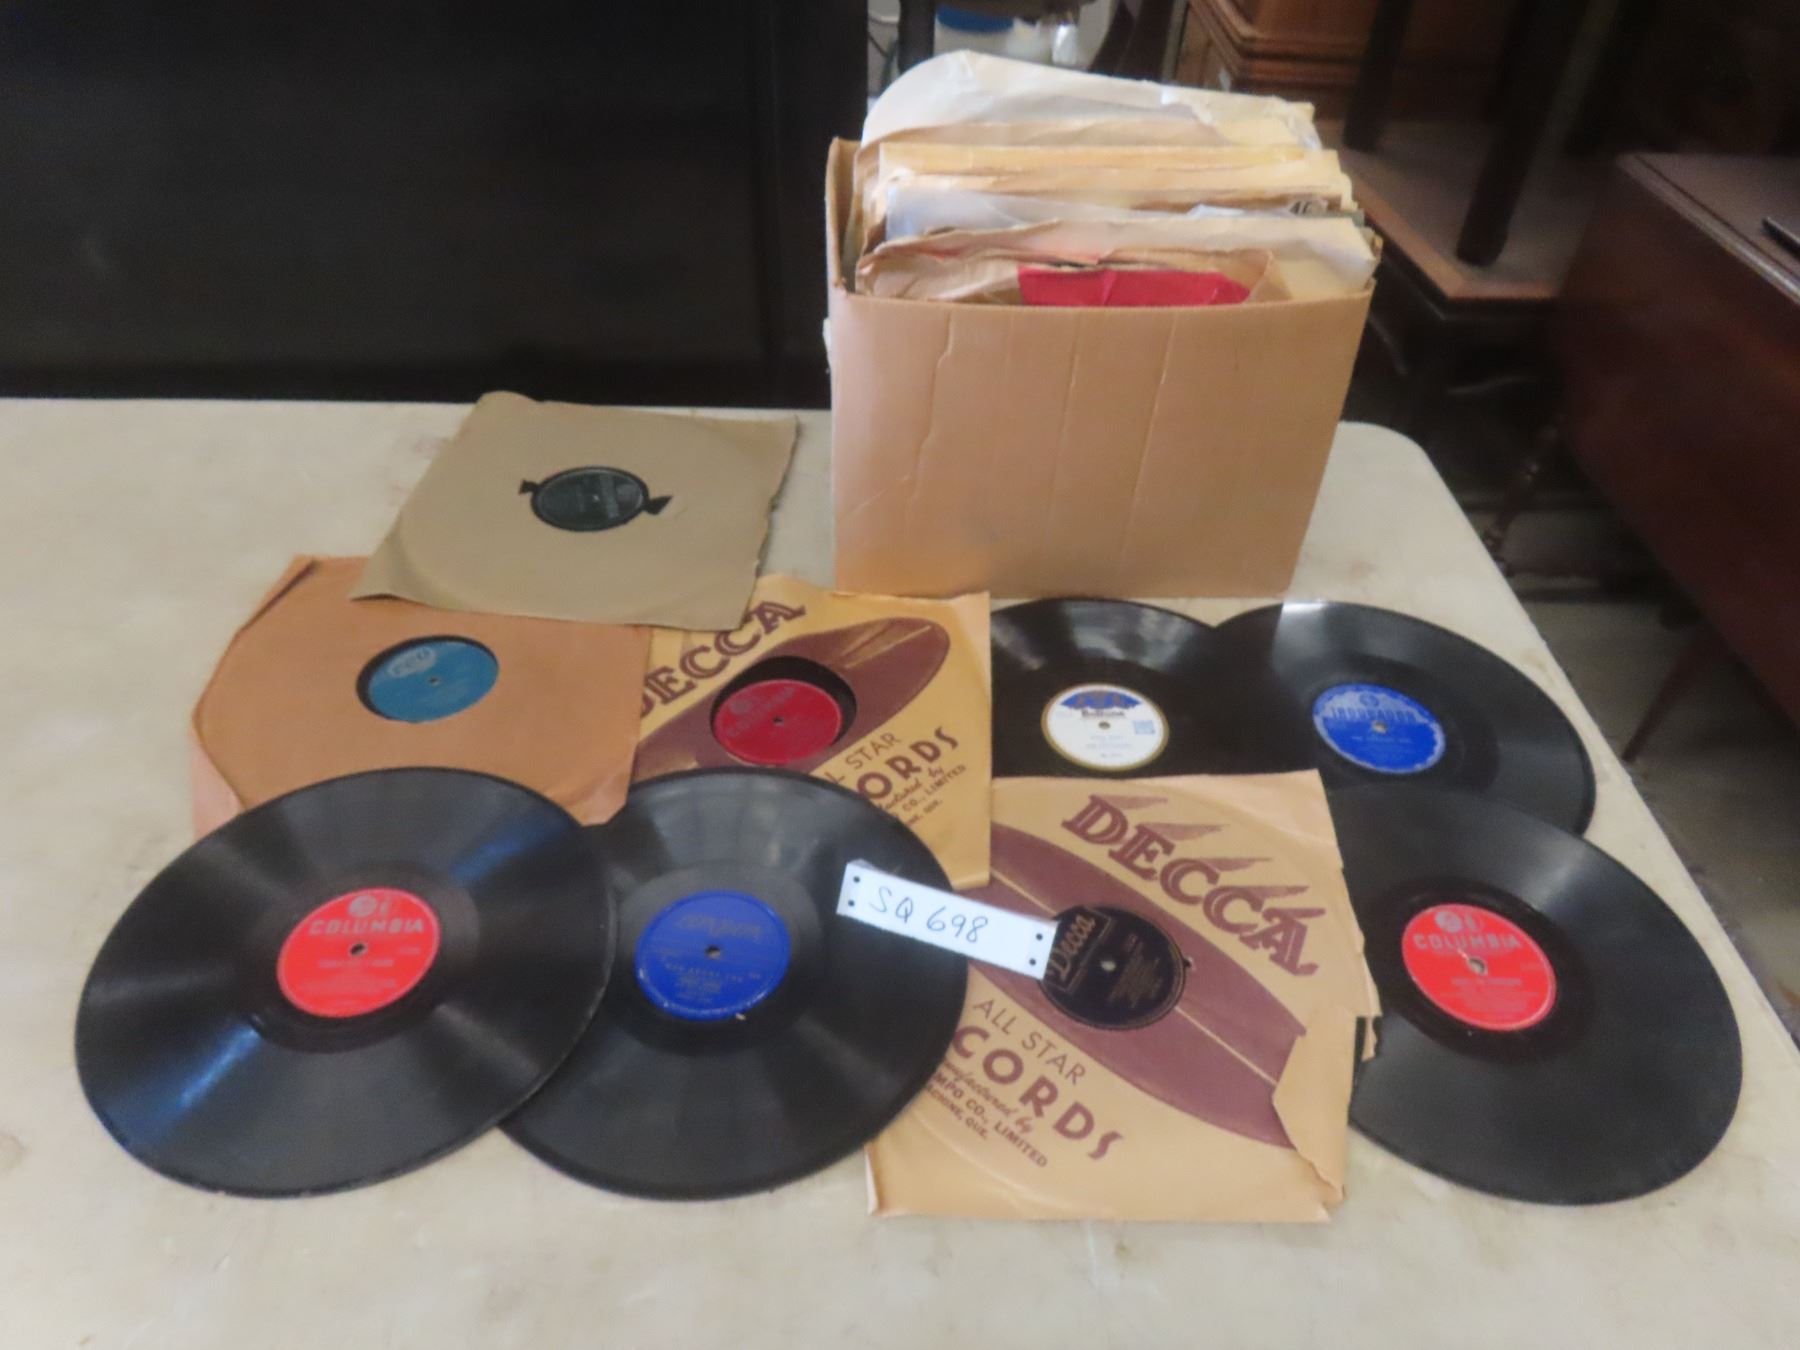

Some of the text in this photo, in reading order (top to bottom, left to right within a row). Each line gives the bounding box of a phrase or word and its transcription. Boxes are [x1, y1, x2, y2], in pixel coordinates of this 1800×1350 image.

[845, 732, 902, 770] STAR
[1061, 794, 1326, 977] DECCA
[309, 919, 424, 936] COLUMBIA
[869, 886, 989, 943] SQ 698
[1413, 934, 1522, 950] COLUMBIA
[973, 1000, 1086, 1085] ALL STAR
[994, 1121, 1048, 1168] LIMITED
